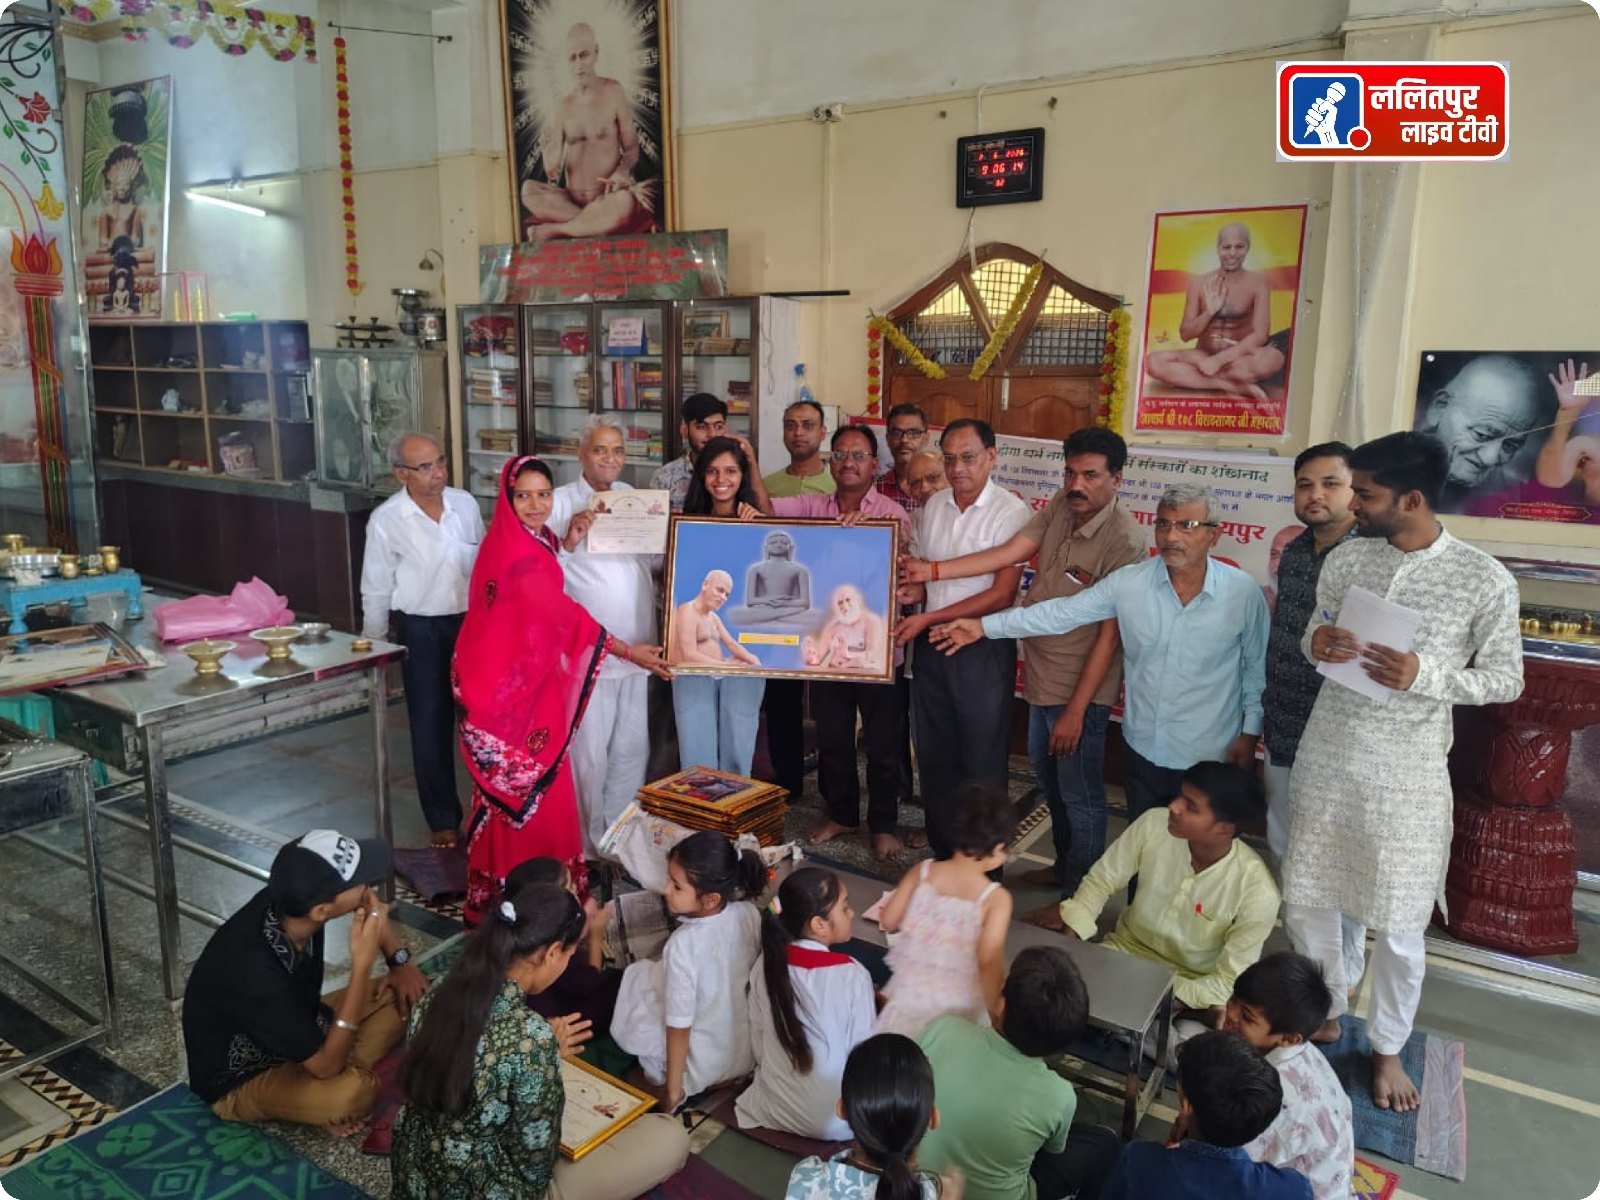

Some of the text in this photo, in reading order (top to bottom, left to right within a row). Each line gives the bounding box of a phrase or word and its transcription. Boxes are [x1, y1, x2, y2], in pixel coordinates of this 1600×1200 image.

[1141, 408, 1165, 426] आचार्य
[1166, 408, 1176, 426] श्री
[1251, 415, 1280, 431] महाराज
[1137, 457, 1189, 474] संस्कारों
[1188, 464, 1207, 476] का
[1210, 463, 1269, 483] शंखनाद
[1219, 521, 1267, 545] यपुर
